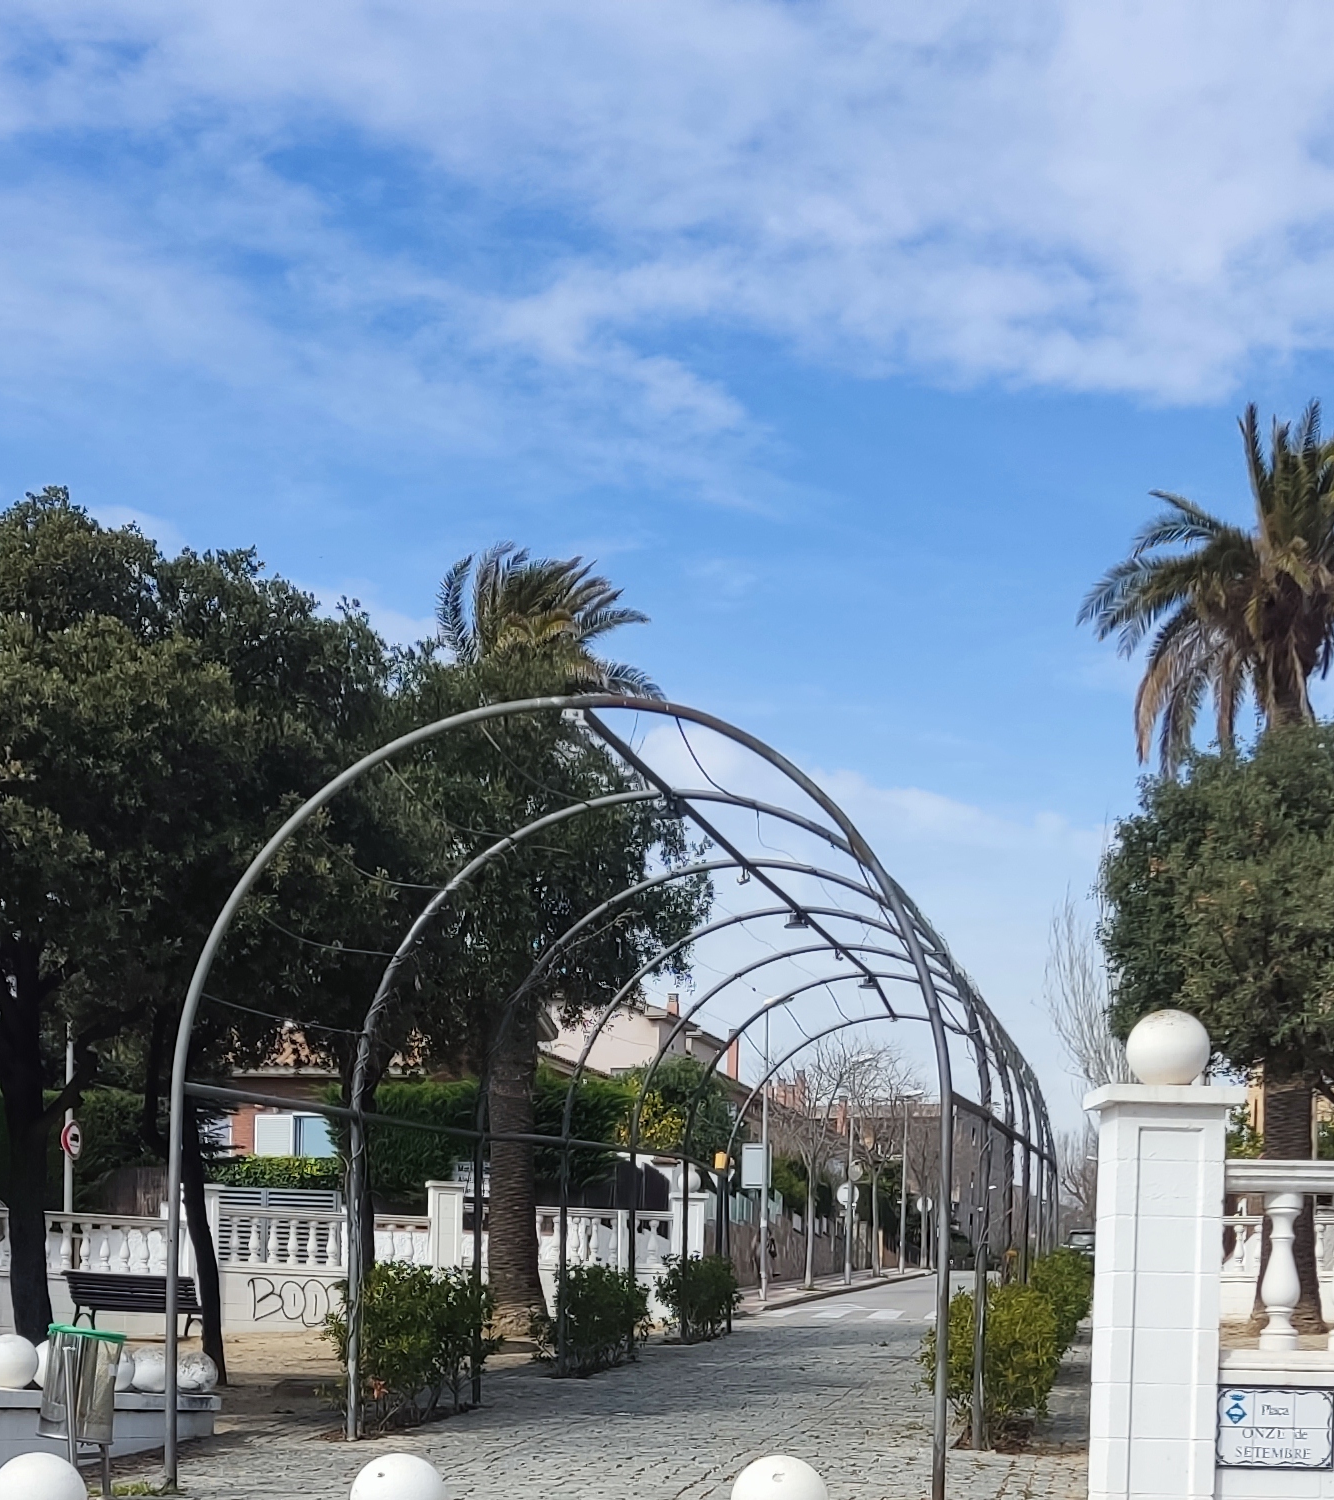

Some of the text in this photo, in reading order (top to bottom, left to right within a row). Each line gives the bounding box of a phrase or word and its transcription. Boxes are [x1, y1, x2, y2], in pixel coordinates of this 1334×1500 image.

[1242, 1428, 1308, 1440] ONZE de
[1235, 1446, 1312, 1460] SETEMBRE
